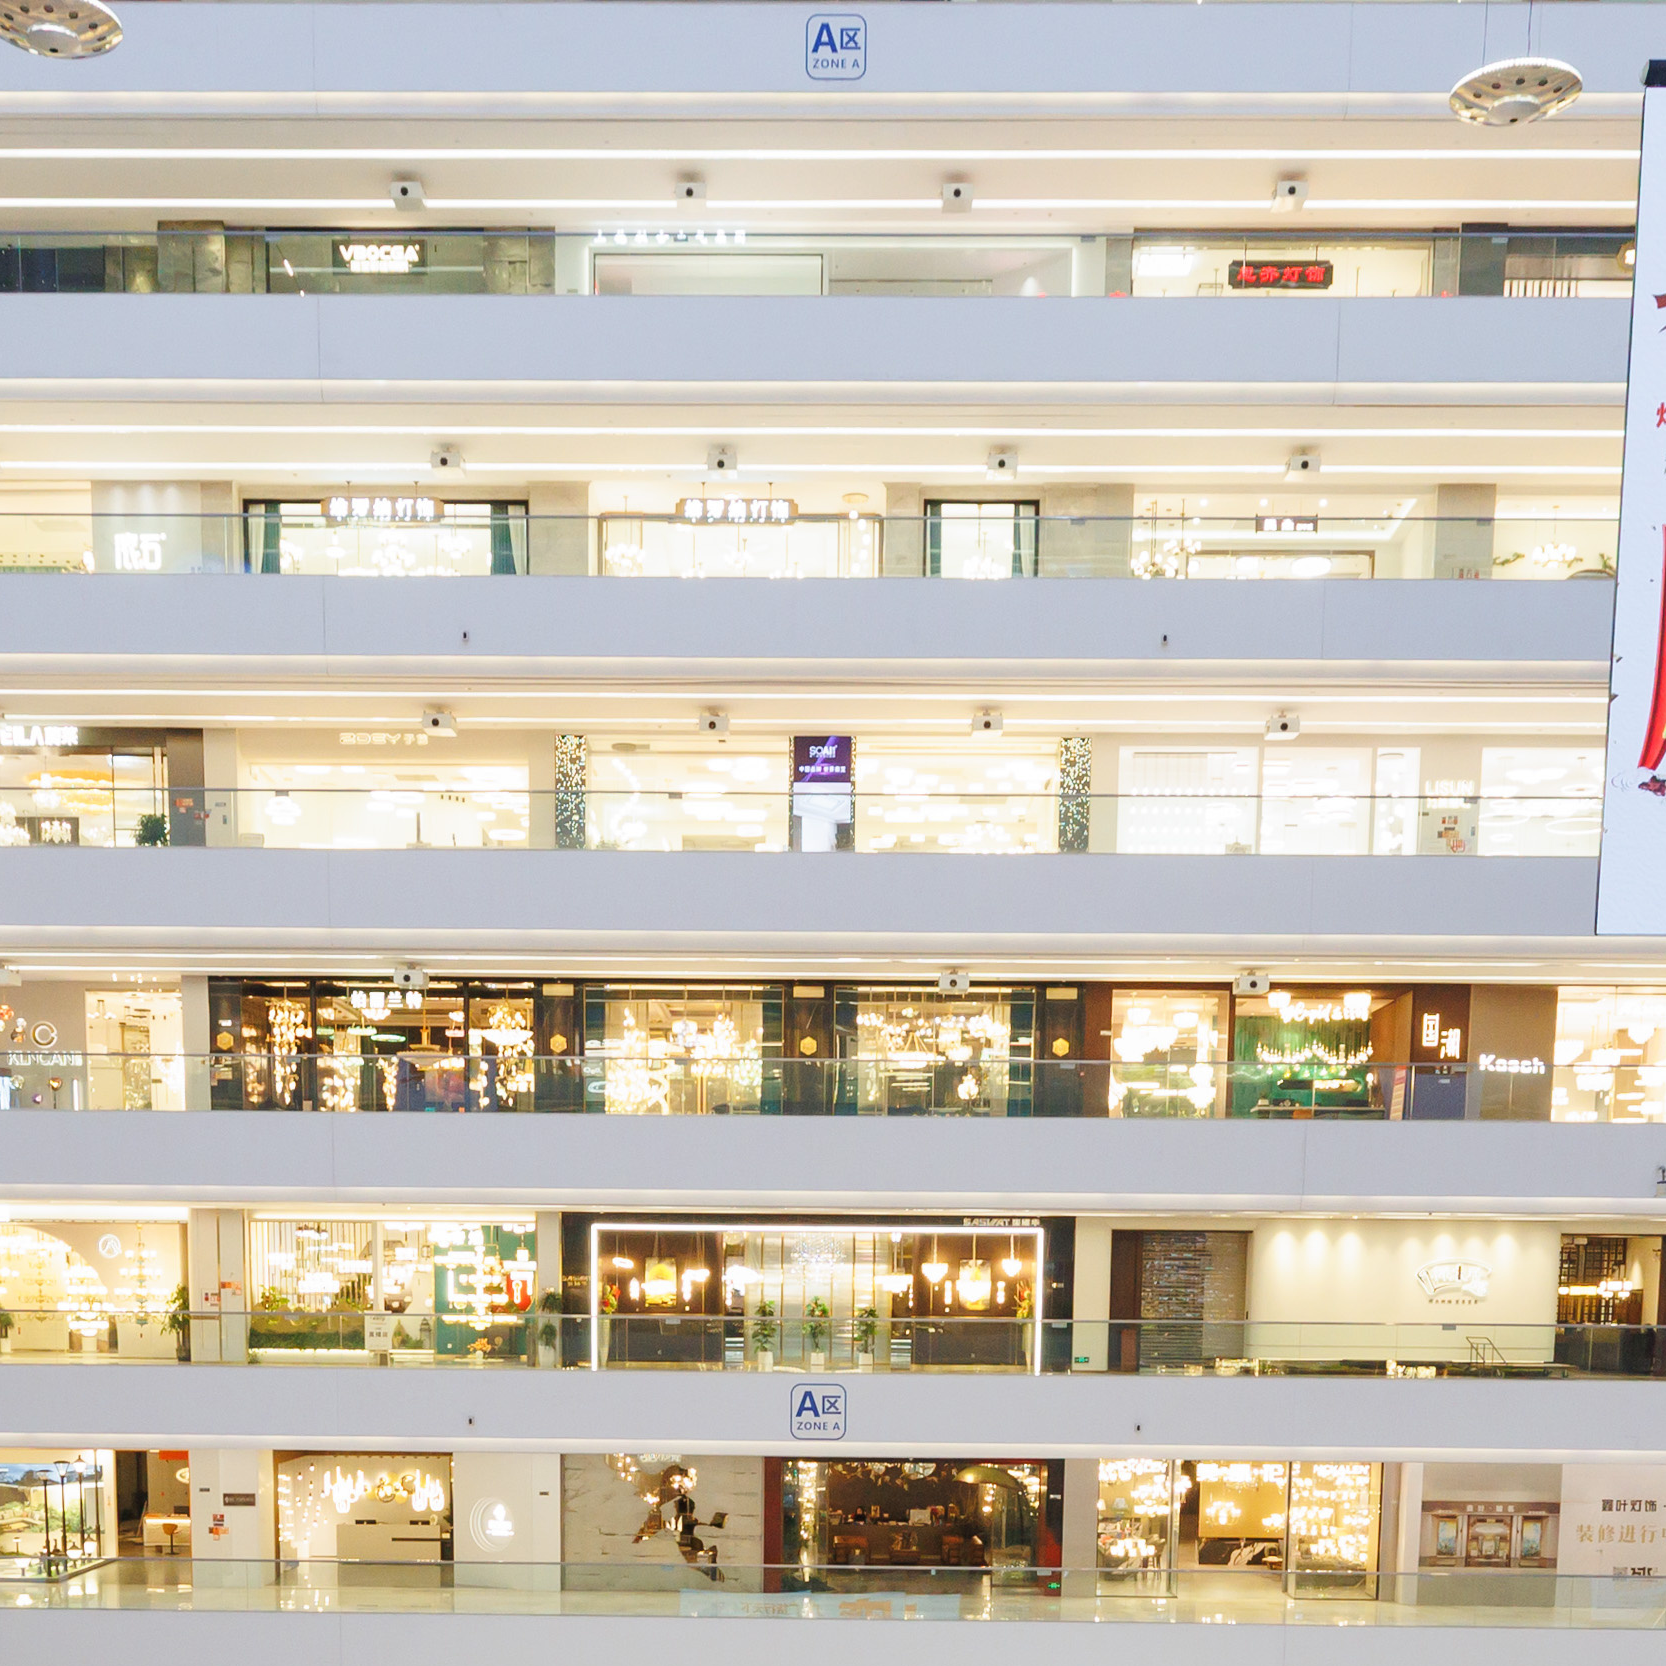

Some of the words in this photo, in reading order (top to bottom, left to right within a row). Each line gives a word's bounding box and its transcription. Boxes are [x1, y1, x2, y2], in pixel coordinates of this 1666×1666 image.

[811, 22, 860, 53] A区
[812, 58, 847, 70] ZONE
[851, 58, 861, 70] A
[796, 1391, 841, 1417] A区
[797, 1422, 828, 1431] ZONE
[833, 1422, 841, 1431] A
